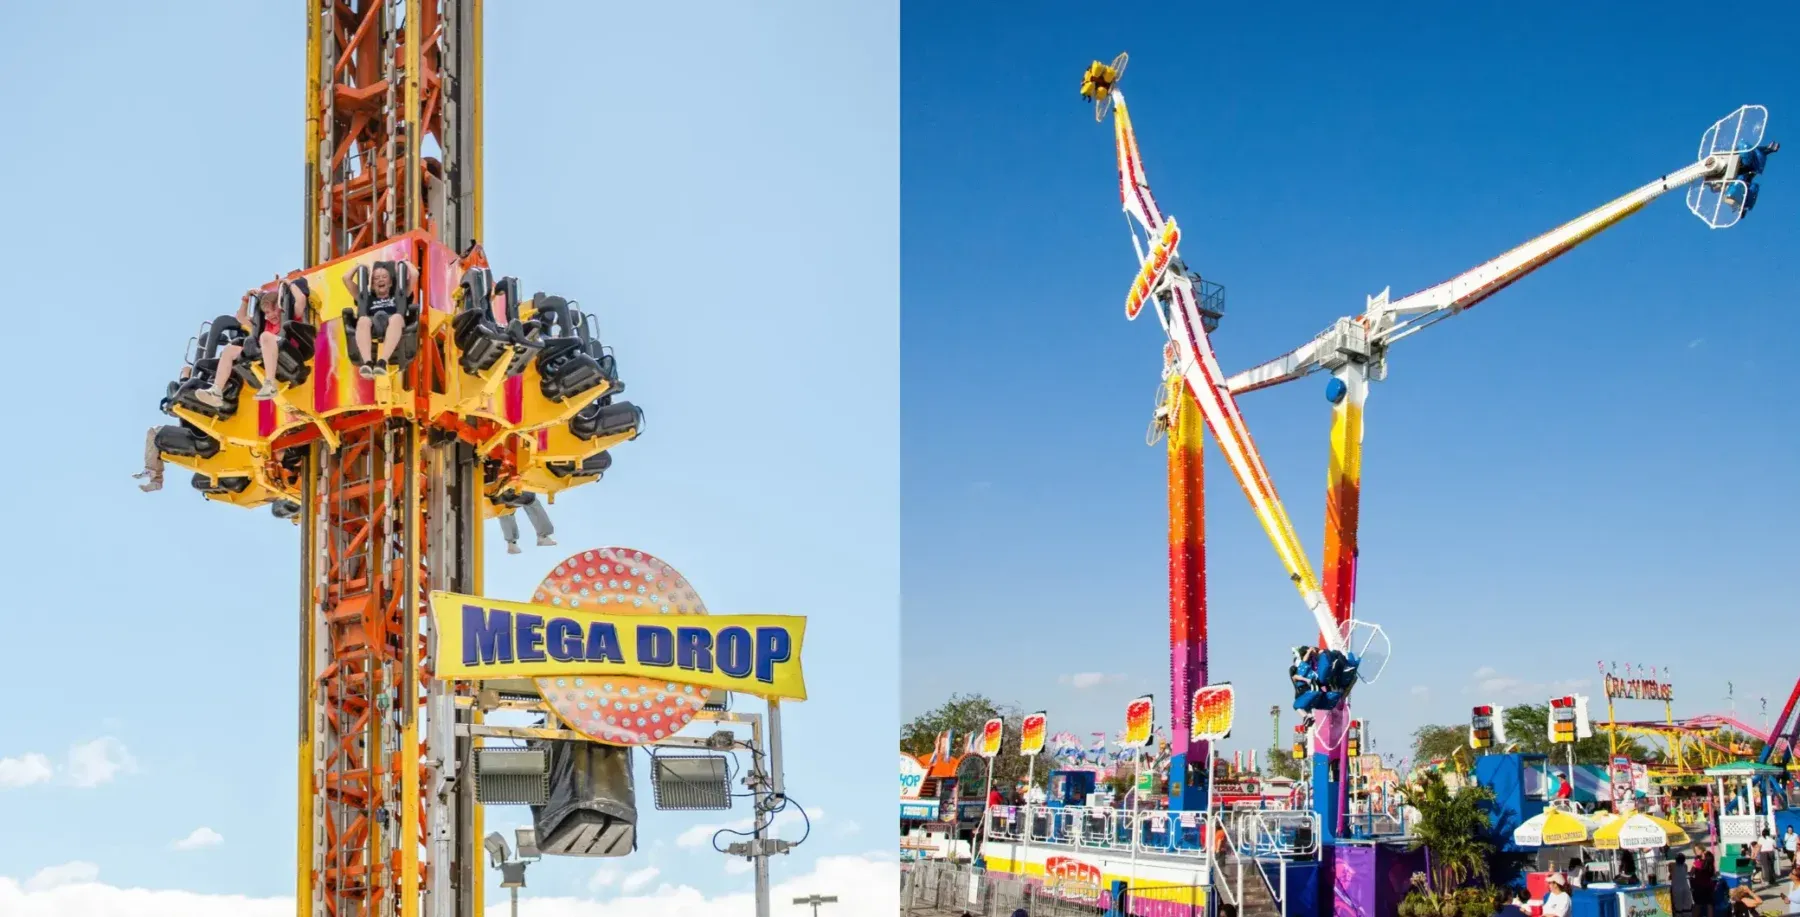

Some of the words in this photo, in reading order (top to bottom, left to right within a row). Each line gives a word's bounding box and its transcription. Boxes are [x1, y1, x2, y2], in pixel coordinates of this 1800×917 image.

[462, 604, 625, 667] MEGA
[636, 625, 792, 683] DROP
[1604, 672, 1640, 699] CRAZY
